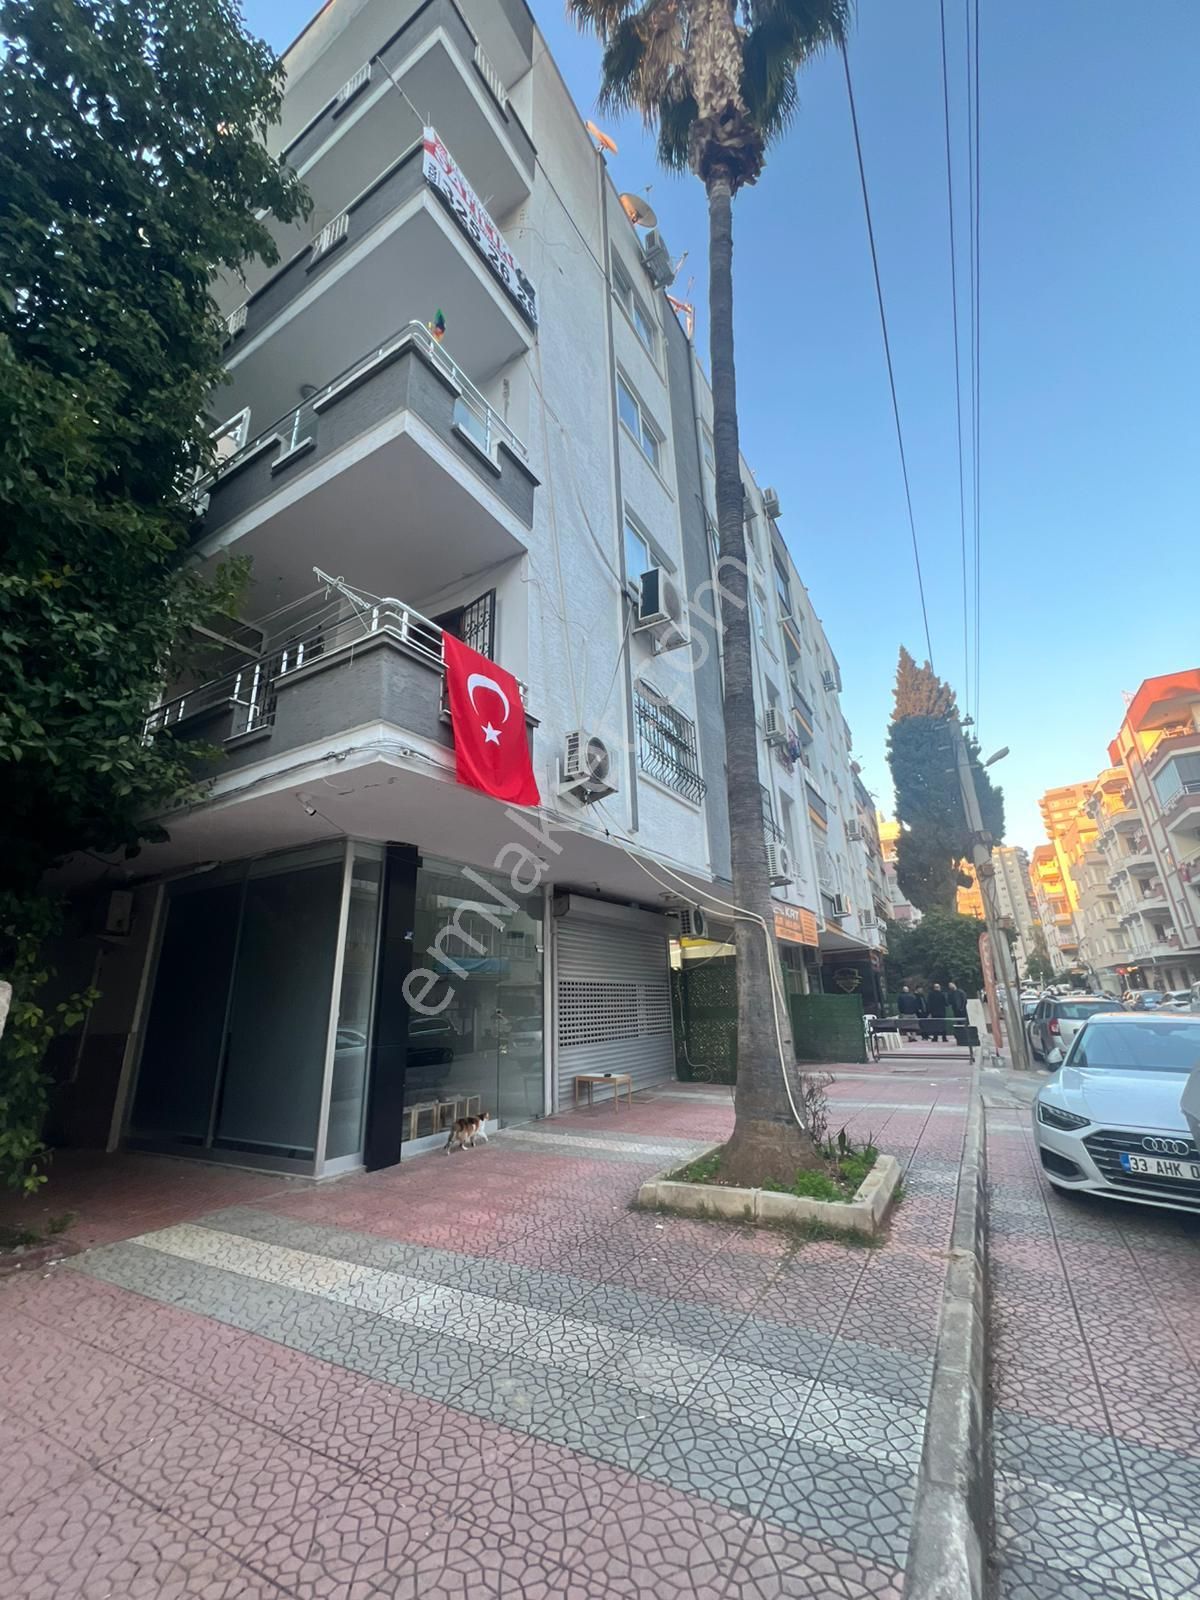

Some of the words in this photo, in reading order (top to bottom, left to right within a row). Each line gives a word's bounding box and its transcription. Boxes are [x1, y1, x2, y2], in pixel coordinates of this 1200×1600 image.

[488, 244, 510, 284] 26
[1130, 1157, 1148, 1172] 33
[1156, 1160, 1184, 1177] AHK
